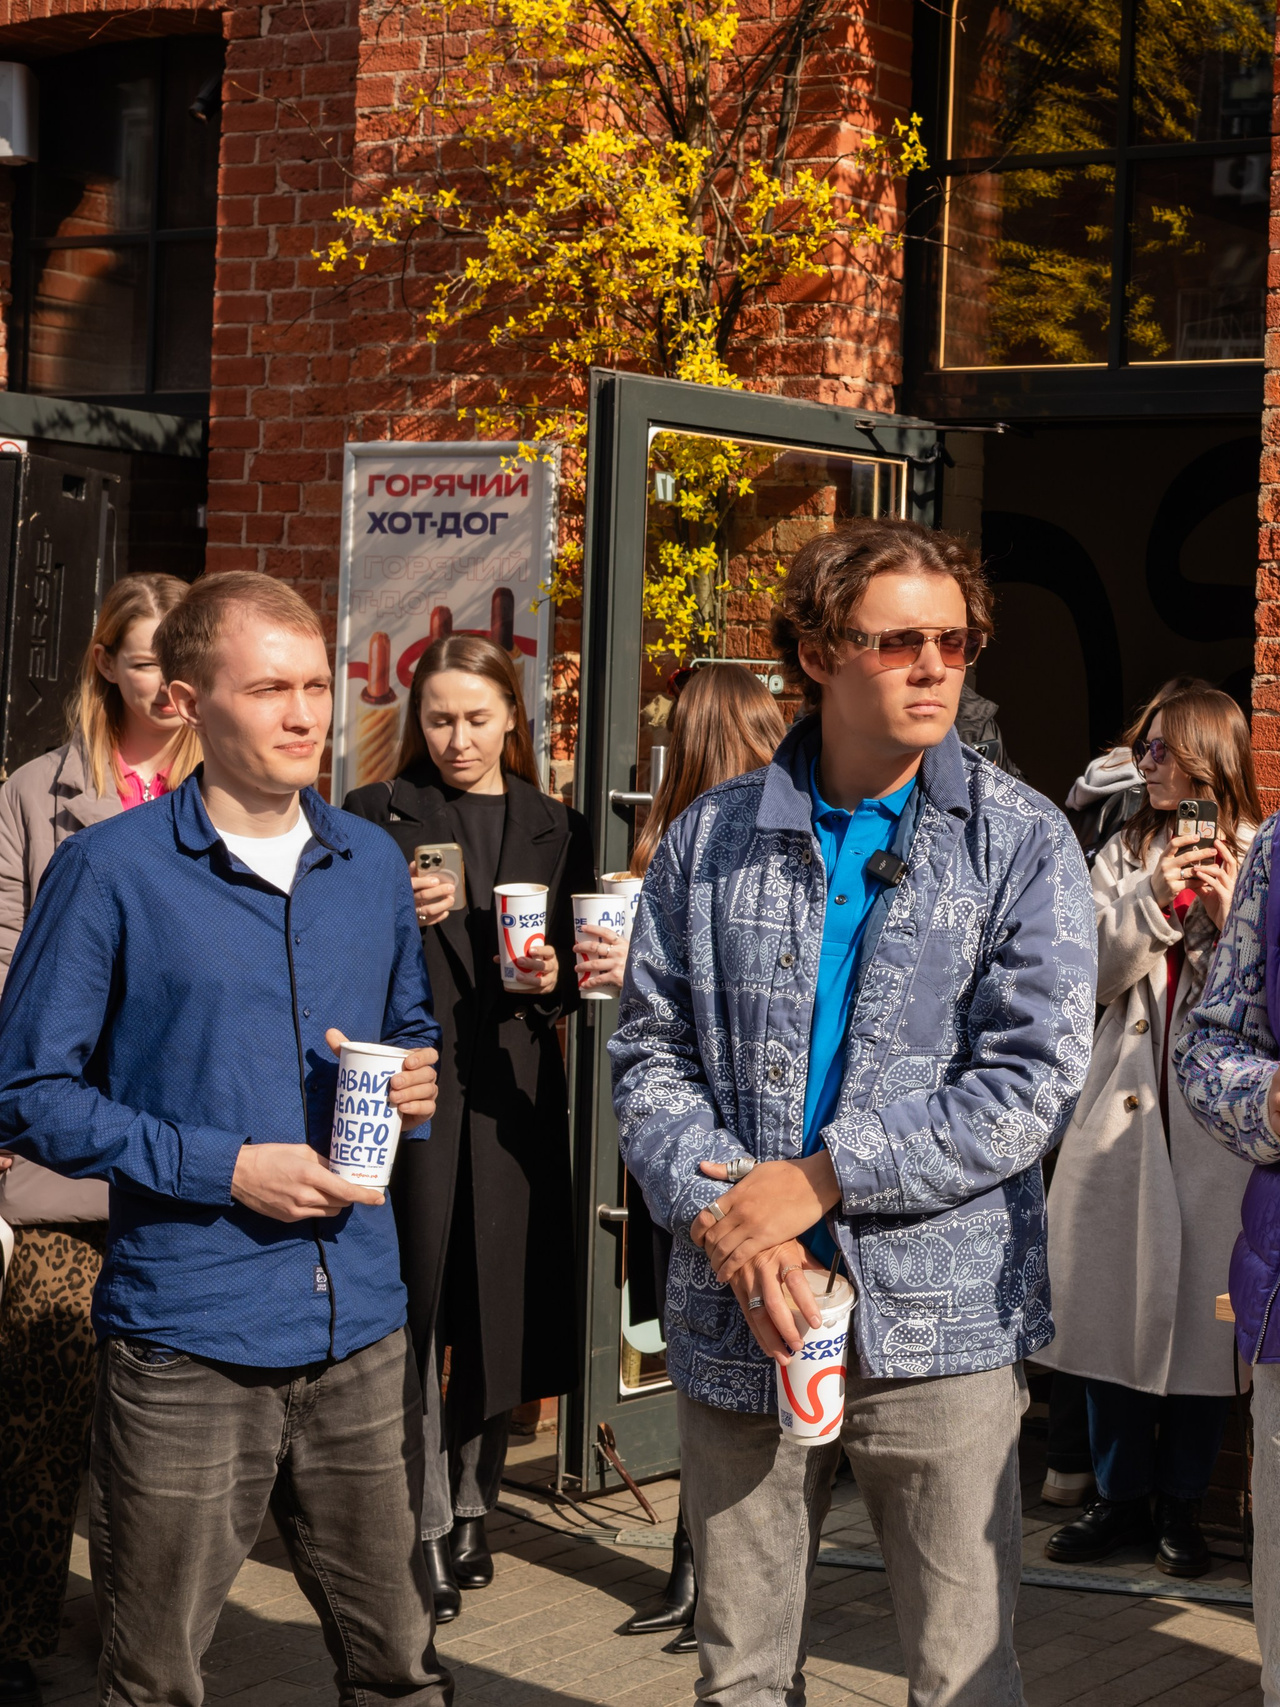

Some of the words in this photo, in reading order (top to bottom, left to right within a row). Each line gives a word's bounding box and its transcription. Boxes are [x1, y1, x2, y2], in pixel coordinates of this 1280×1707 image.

[367, 468, 529, 497] ГОРЯЧИЙ
[366, 511, 509, 538] ХОТ-ДОГ
[363, 552, 528, 582] ГОРЯЧИЙ
[351, 590, 447, 618] Т-ДОГ
[336, 1068, 396, 1097] АВАЙ
